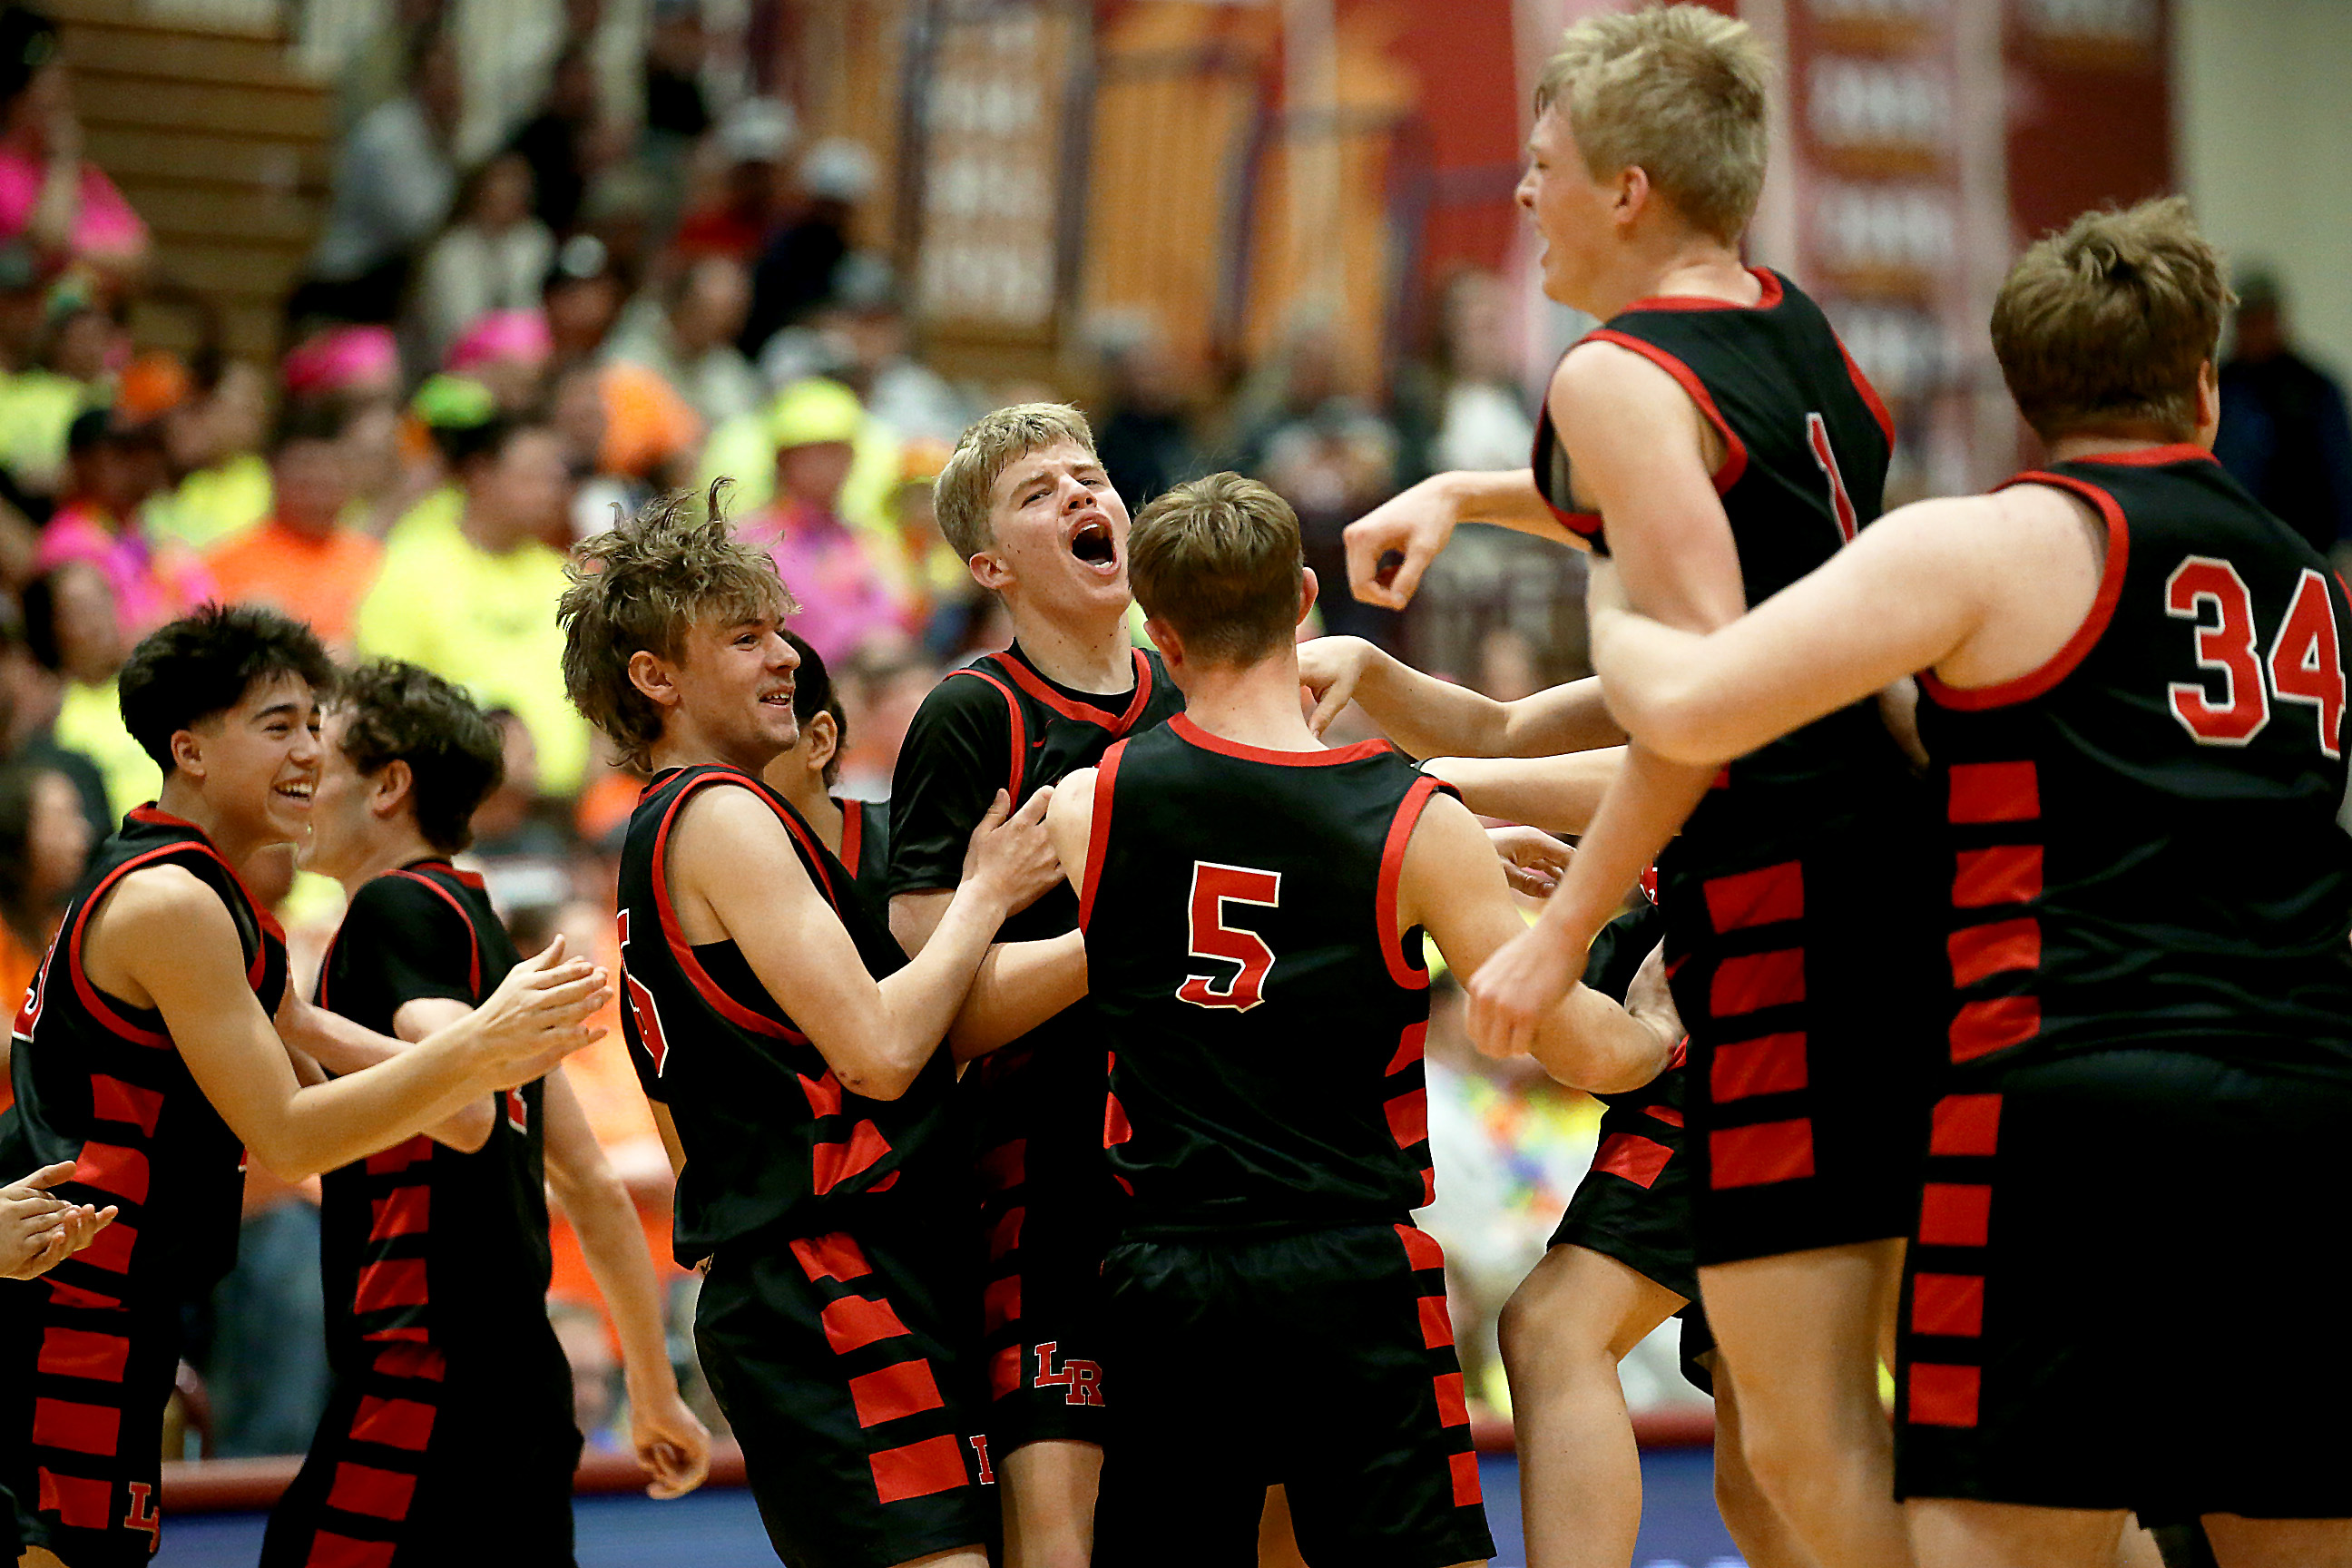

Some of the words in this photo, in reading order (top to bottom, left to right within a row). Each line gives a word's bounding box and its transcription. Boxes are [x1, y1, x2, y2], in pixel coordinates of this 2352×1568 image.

[2165, 554, 2347, 760] 34
[1175, 859, 1281, 1014] 5
[1034, 1341, 1106, 1406] LR
[124, 1480, 161, 1553] L
